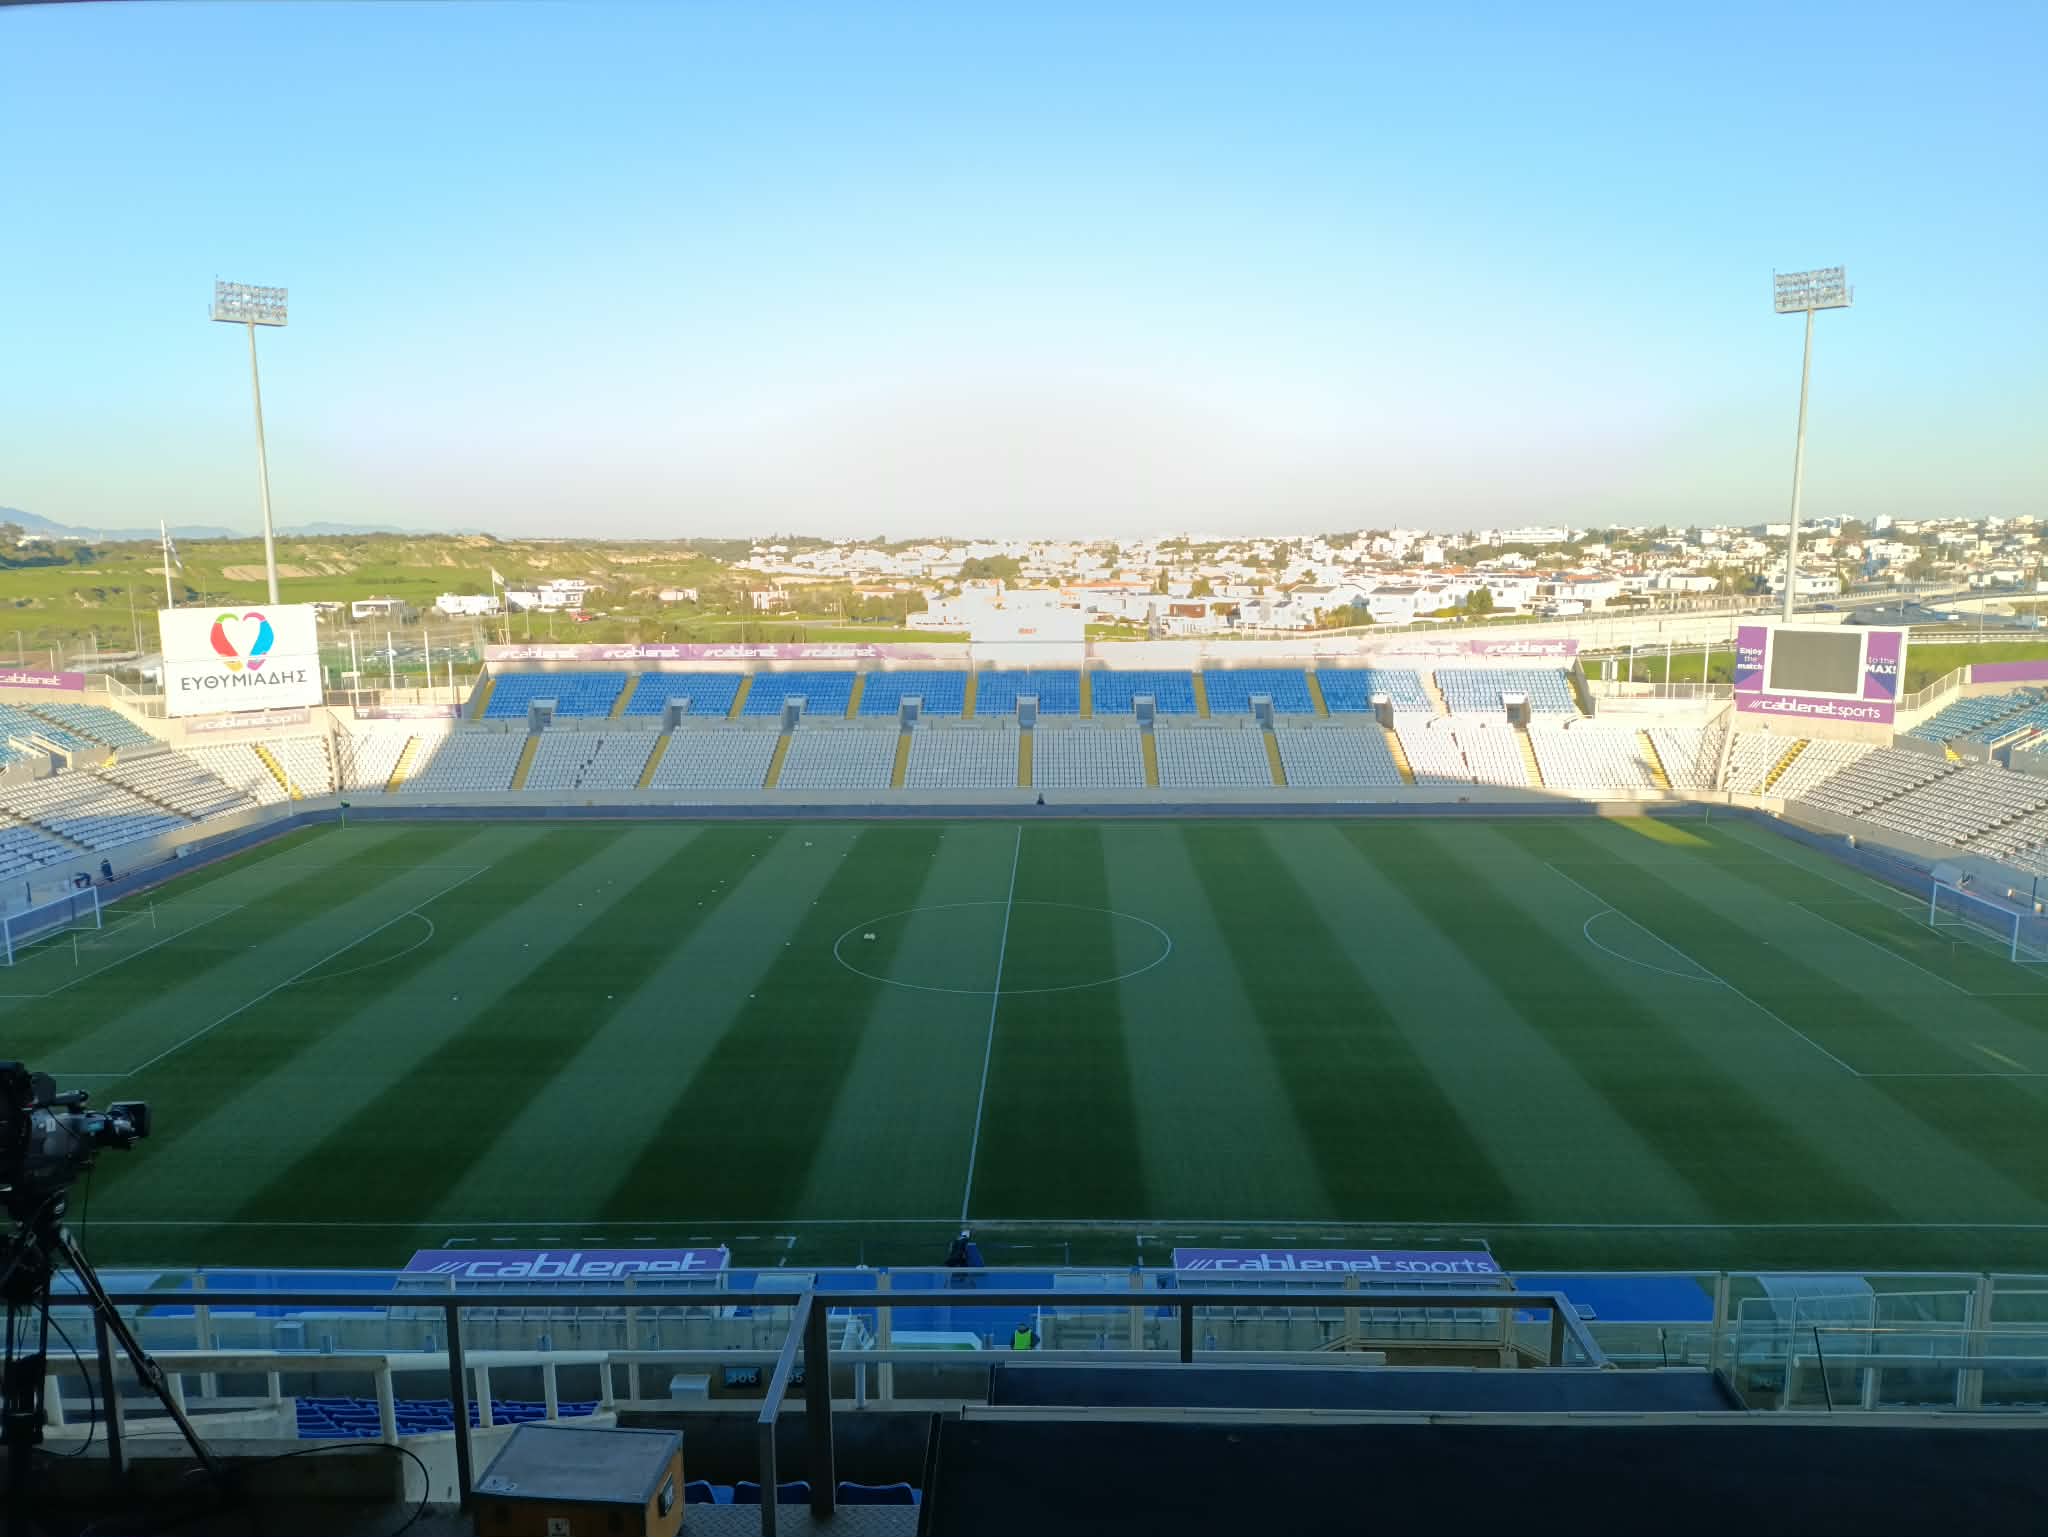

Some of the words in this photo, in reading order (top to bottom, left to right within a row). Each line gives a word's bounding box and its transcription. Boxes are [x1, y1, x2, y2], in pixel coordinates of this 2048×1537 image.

[1739, 647, 1763, 656] Enjoy
[1866, 664, 1897, 674] MAX!
[180, 670, 308, 691] ΕΥΘΥΜΙΑΔΗΣ
[464, 1252, 707, 1277] cablenet
